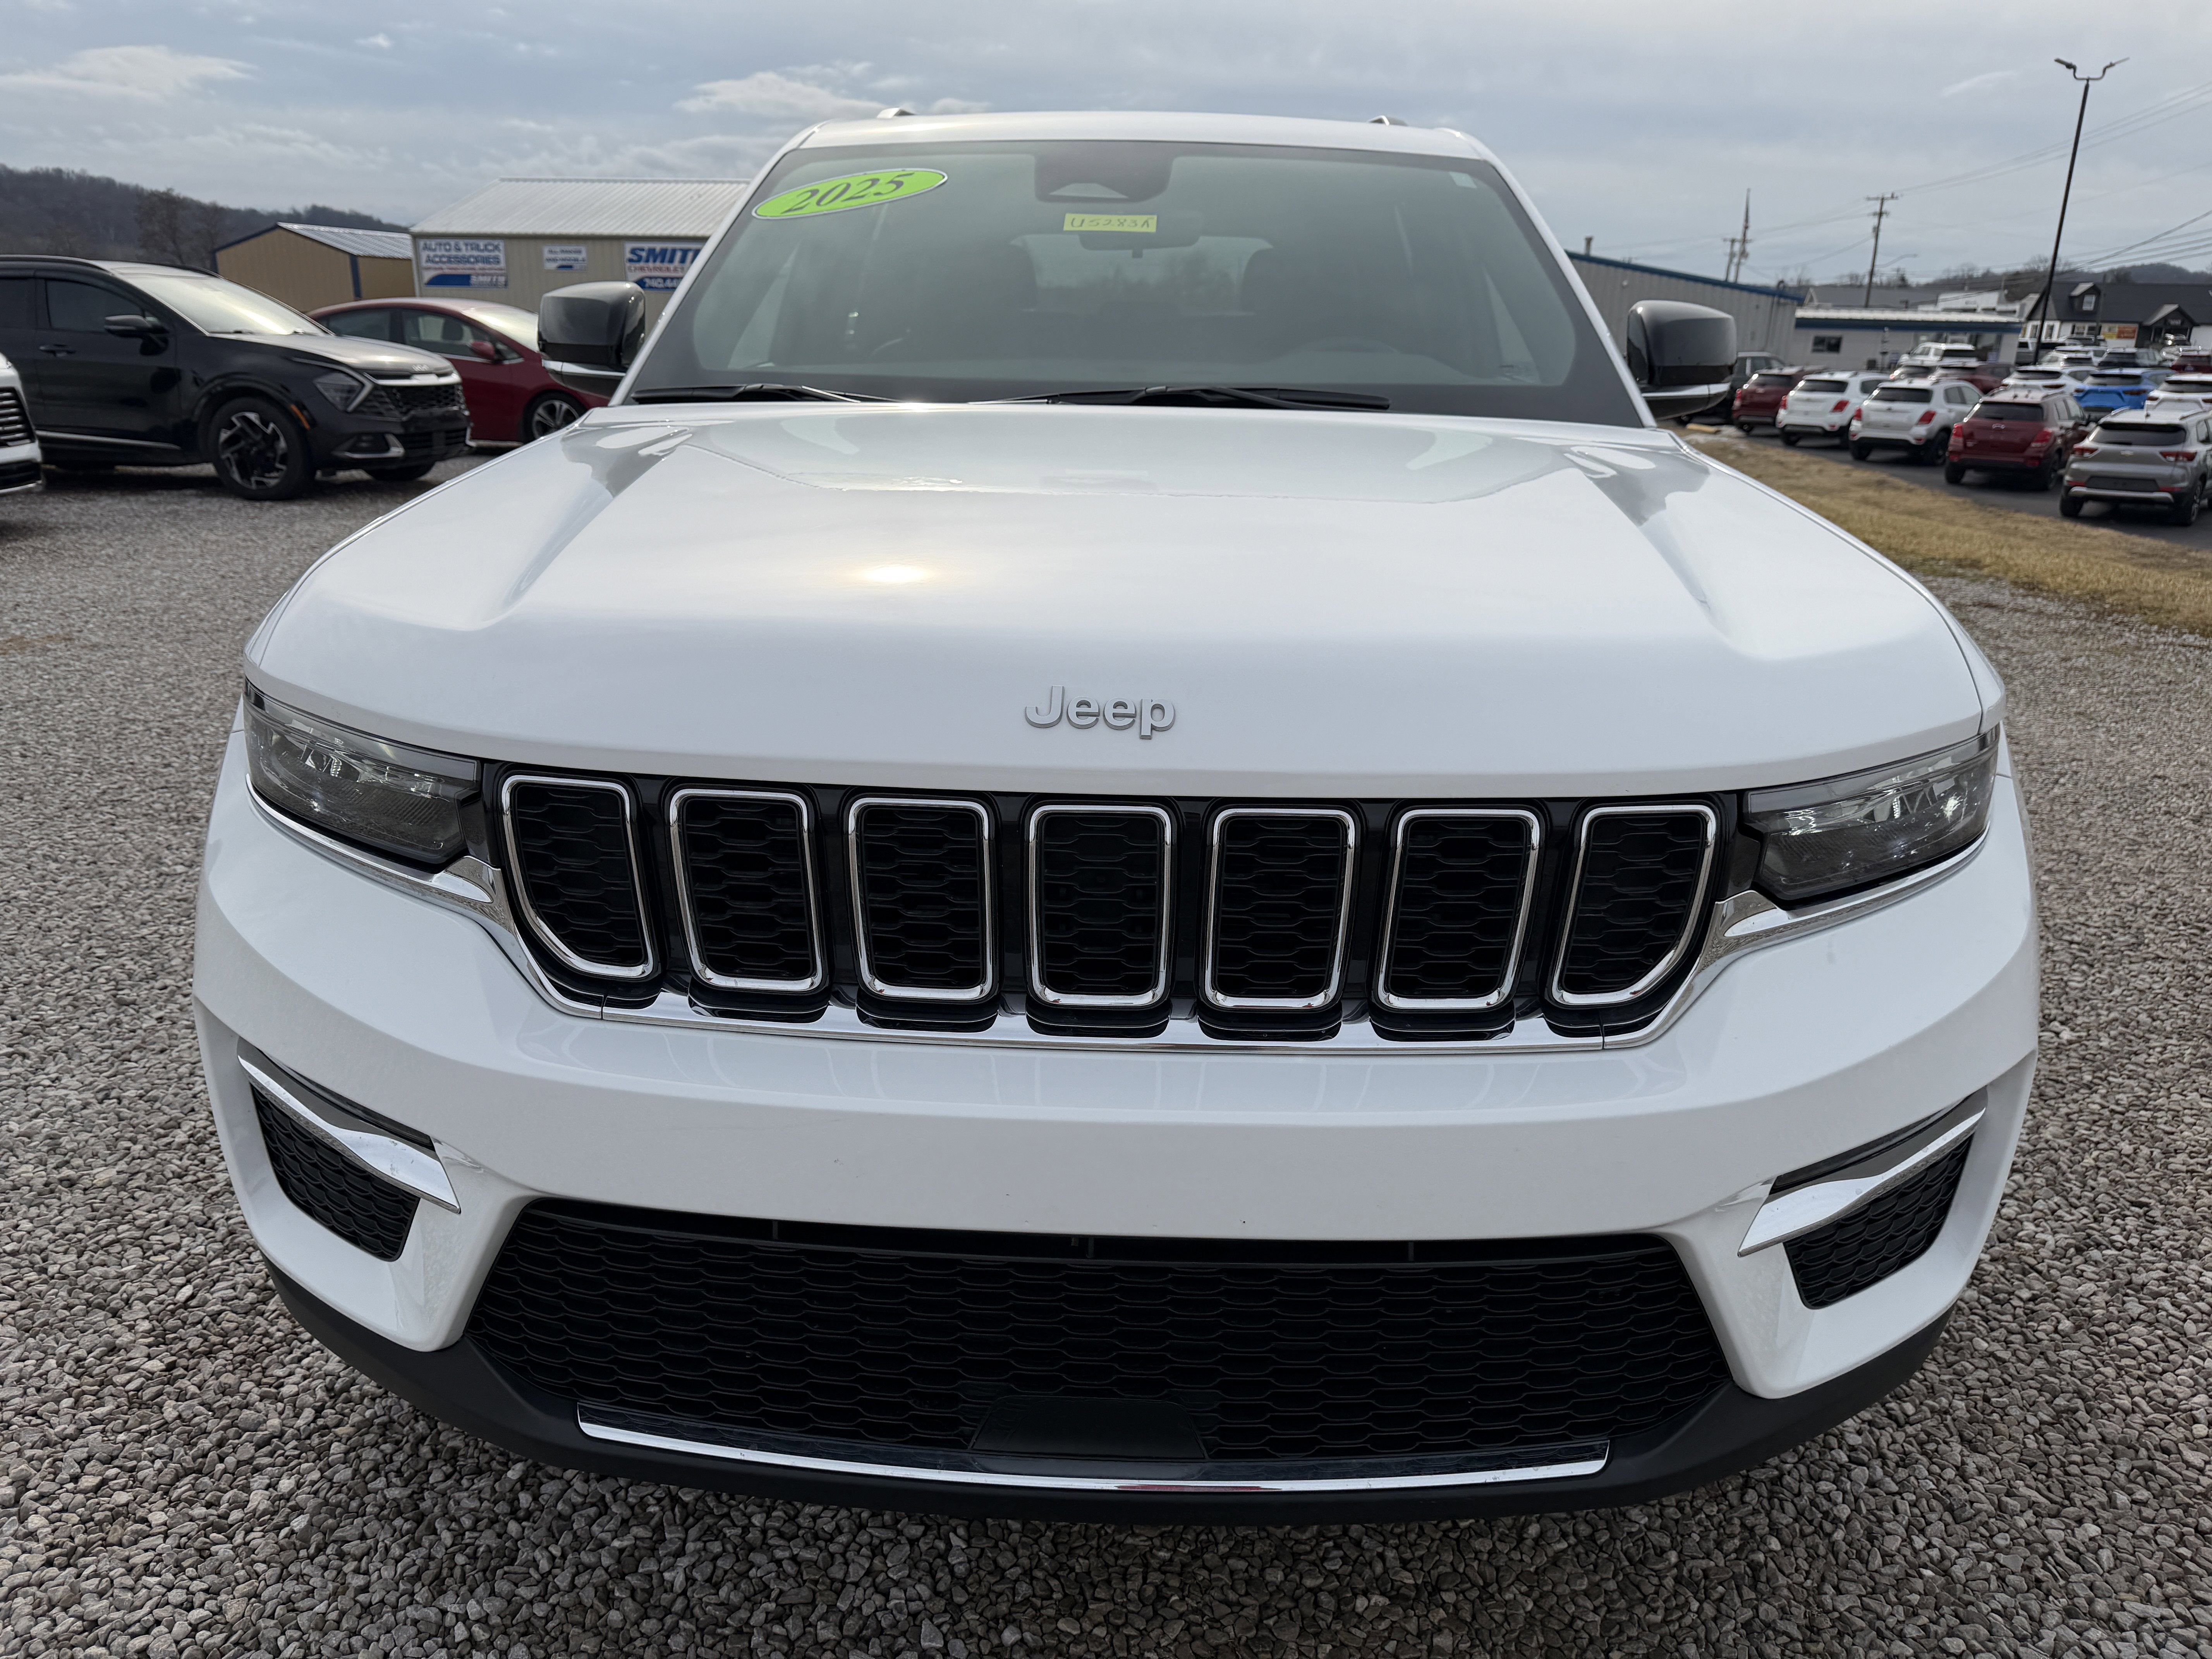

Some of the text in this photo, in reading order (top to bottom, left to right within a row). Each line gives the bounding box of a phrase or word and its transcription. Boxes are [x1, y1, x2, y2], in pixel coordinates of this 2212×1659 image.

[780, 172, 915, 214] 2025
[422, 241, 501, 252] AUTO & TRUCK
[426, 254, 500, 264] ACCESSORIES
[643, 277, 682, 288] 740.44
[1025, 685, 1175, 739] Jeep
